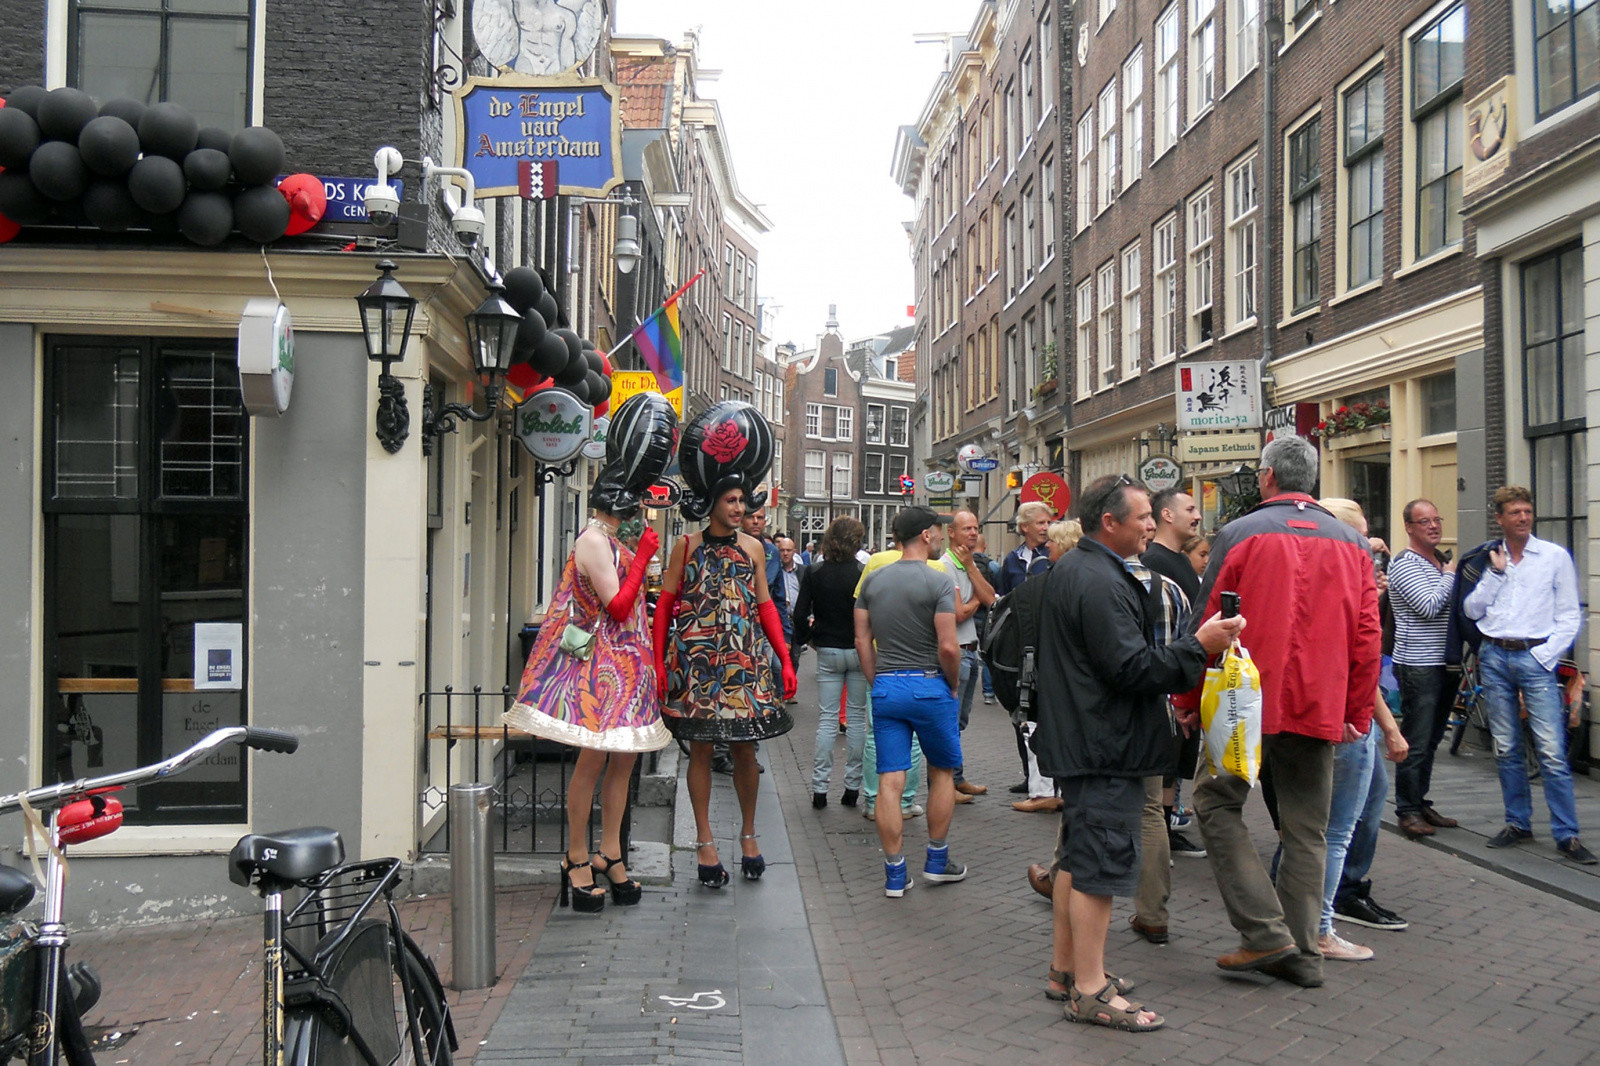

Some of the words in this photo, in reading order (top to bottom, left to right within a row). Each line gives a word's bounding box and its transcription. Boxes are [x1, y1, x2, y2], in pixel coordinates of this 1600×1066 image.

[489, 96, 513, 117] de
[518, 94, 586, 121] Engel
[521, 121, 560, 136] van
[474, 133, 601, 157] Amsterdam
[622, 379, 636, 390] the
[521, 410, 584, 436] Grolsch
[1191, 413, 1249, 427] morita-ya
[1188, 446, 1219, 455] Japans
[1222, 443, 1256, 452] Eethuis
[1144, 468, 1177, 480] Grolsch
[192, 700, 211, 713] de
[1227, 689, 1237, 717] Herald
[185, 717, 219, 735] Engel
[1228, 718, 1242, 772] International
